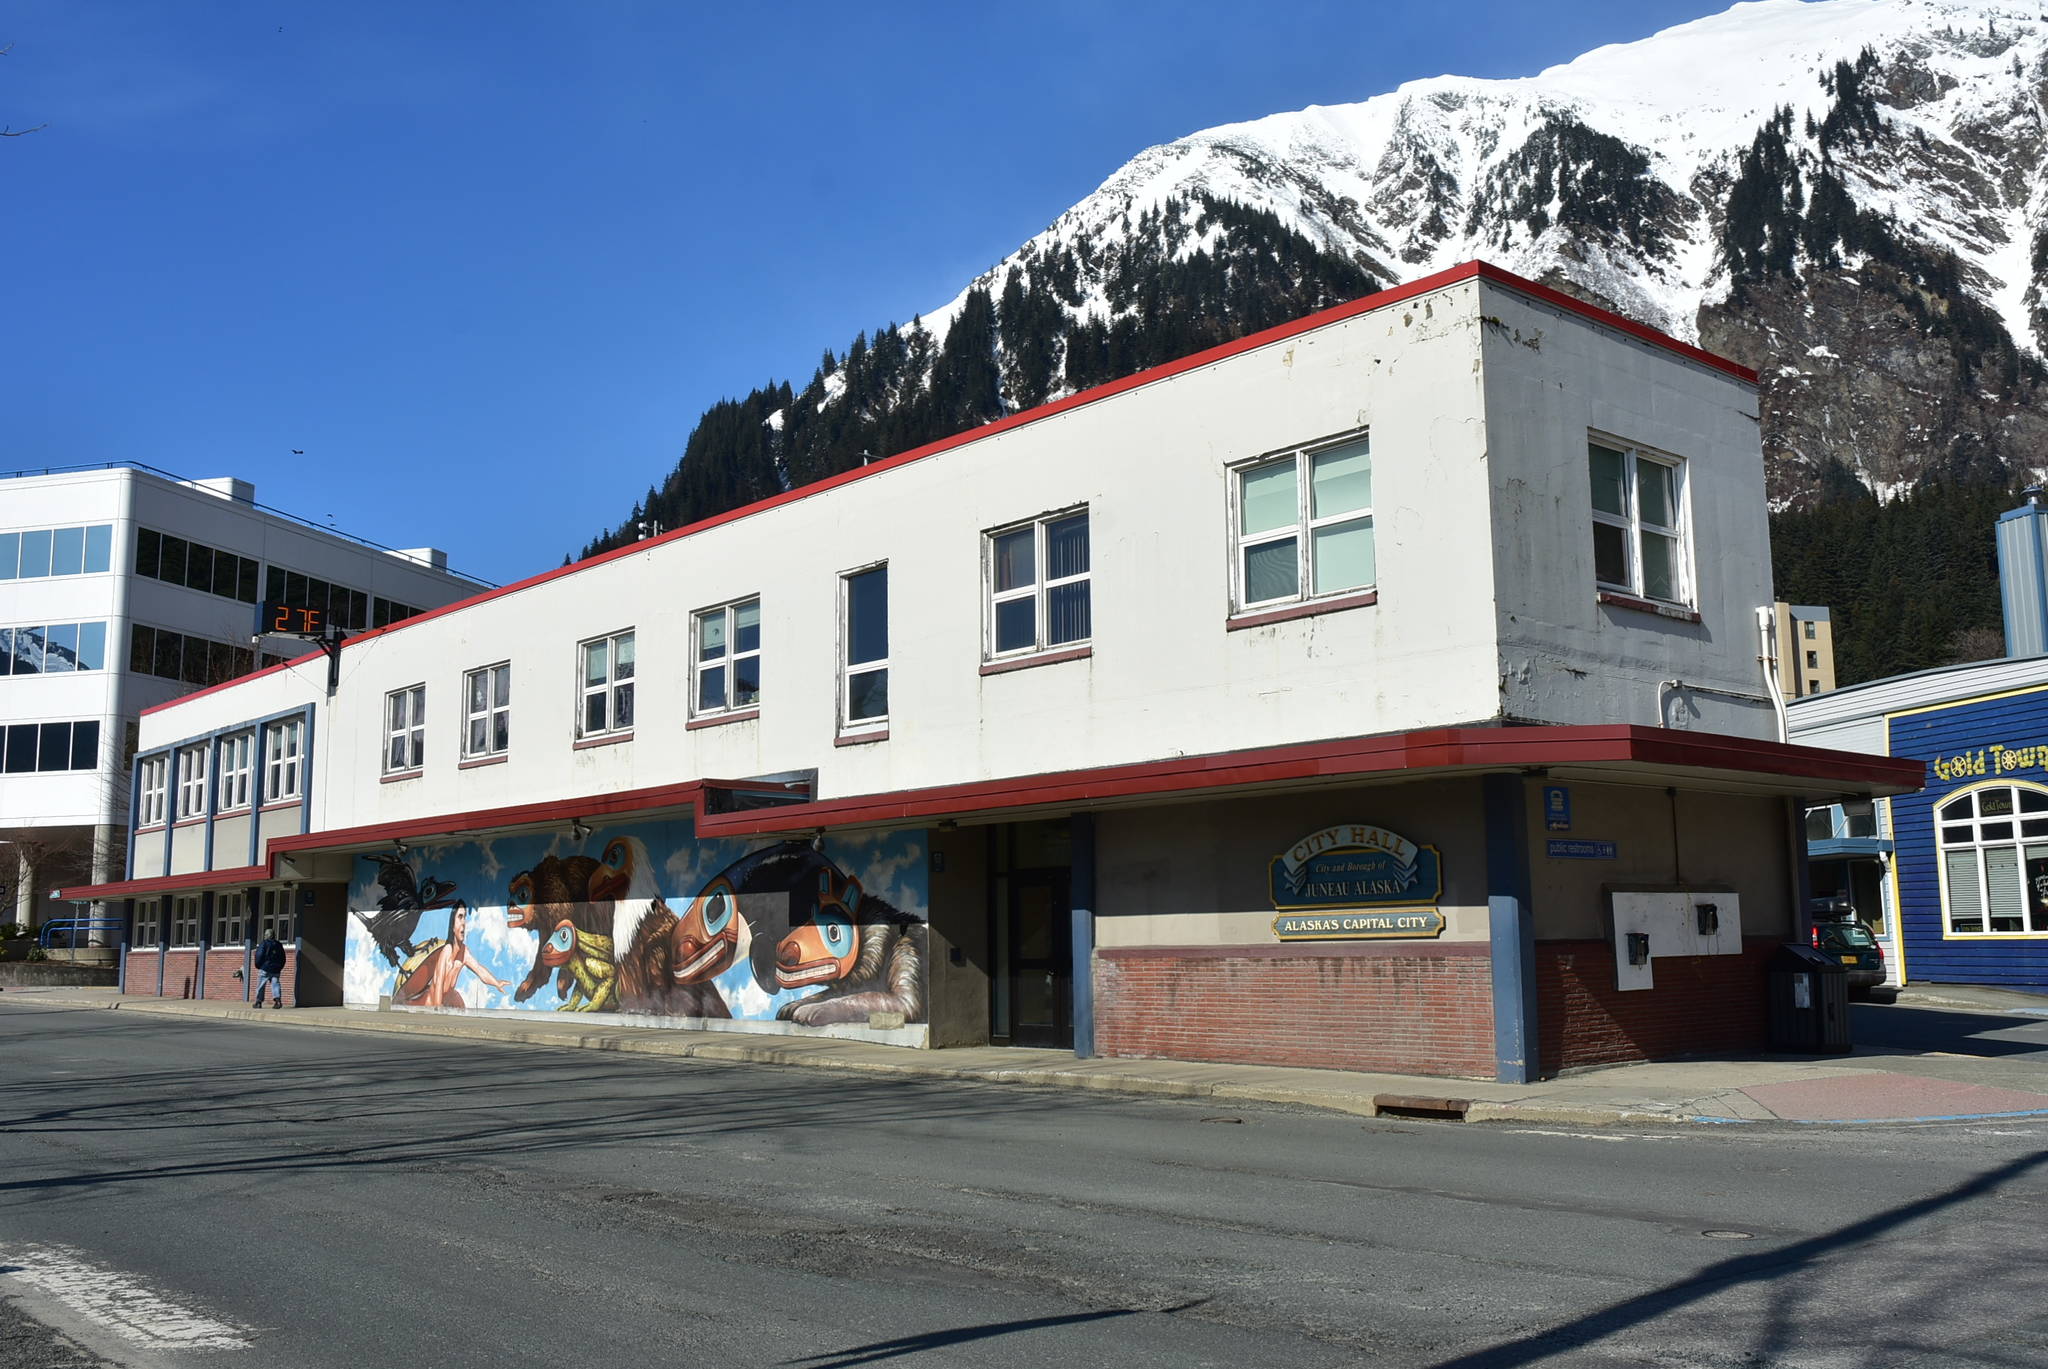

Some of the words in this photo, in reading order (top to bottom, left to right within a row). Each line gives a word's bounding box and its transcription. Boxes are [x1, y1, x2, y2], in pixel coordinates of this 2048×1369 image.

[1934, 749, 1986, 781] Gold
[1293, 829, 1339, 861] CITY
[1350, 827, 1407, 858] HALL
[1315, 863, 1330, 874] City
[1330, 864, 1345, 872] and
[1347, 862, 1376, 873] Borough
[1377, 861, 1386, 870] of
[1305, 881, 1350, 897] JUNEAU
[1354, 879, 1401, 896] ALASKA
[1284, 919, 1340, 932] ALASKA'S
[1343, 917, 1394, 930] CAPITAL
[1397, 916, 1428, 929] CITY
